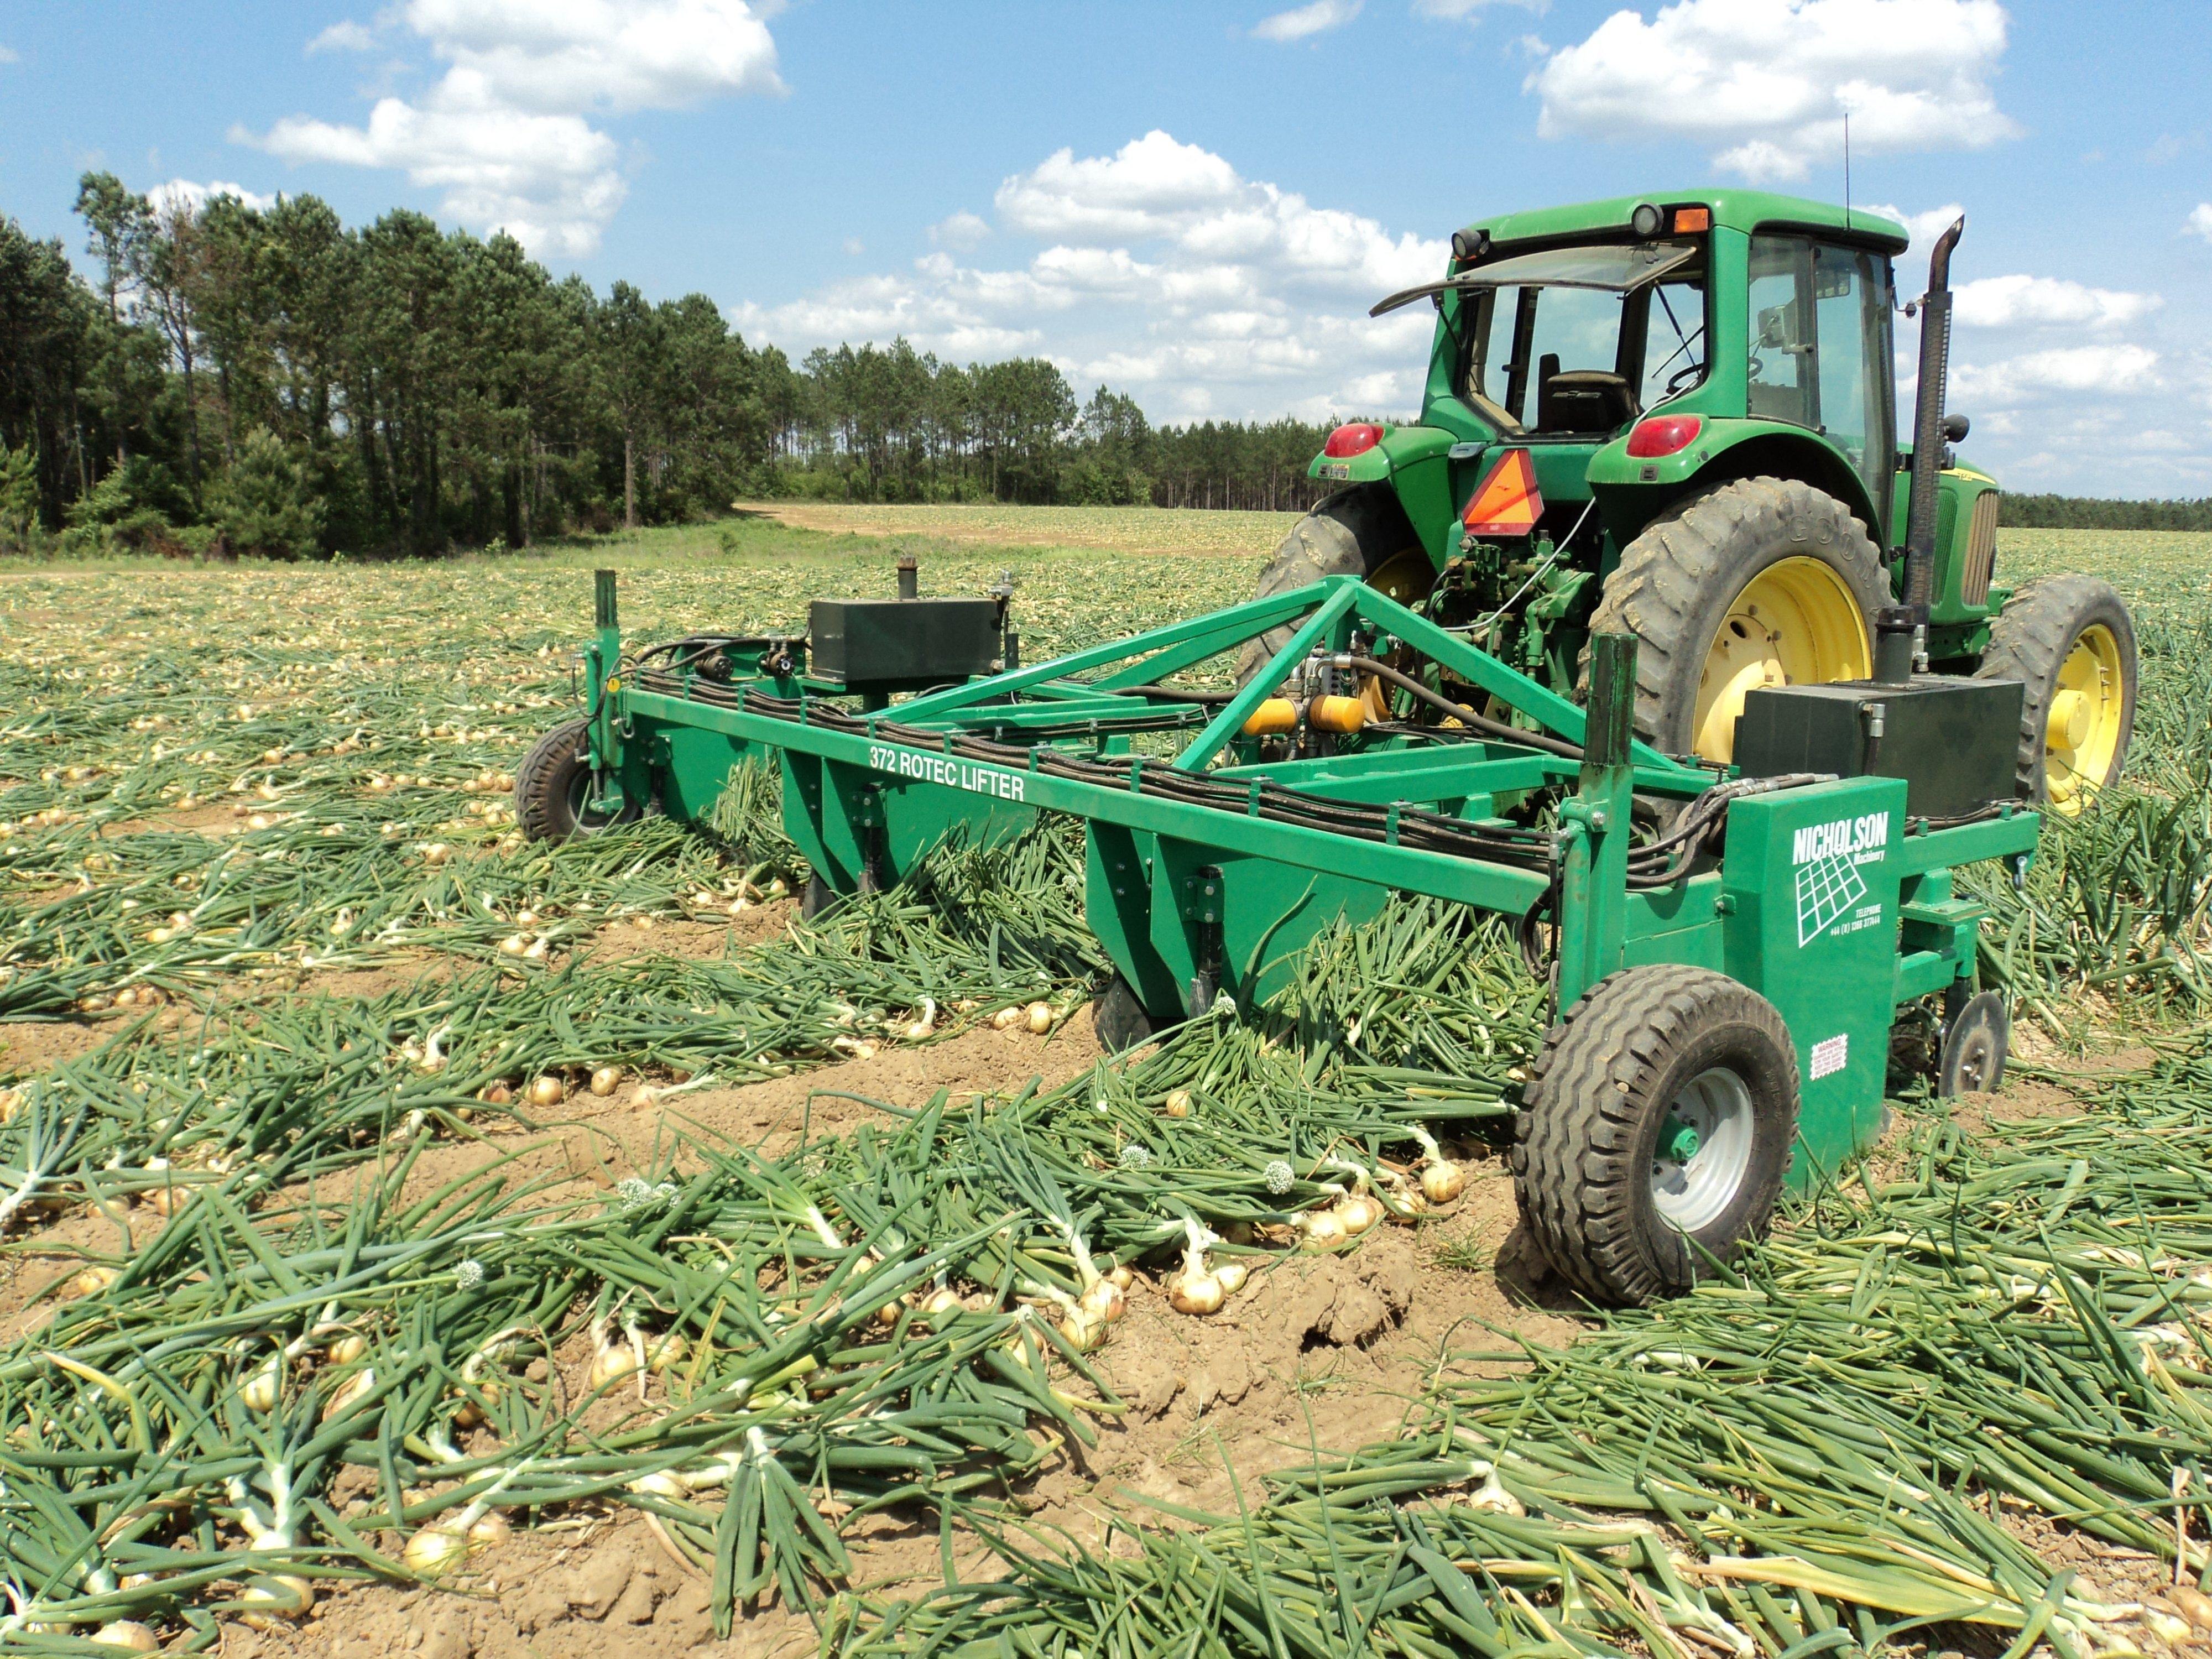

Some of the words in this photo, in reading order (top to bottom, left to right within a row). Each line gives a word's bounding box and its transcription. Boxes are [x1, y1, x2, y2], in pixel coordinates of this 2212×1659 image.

[869, 745, 895, 773] 372
[900, 752, 957, 786] ROTEC
[962, 765, 1025, 802] LIFTER
[1793, 811, 1888, 865] NICHOLSON
[1854, 850, 1885, 865] Machinery
[1856, 903, 1881, 919] TELEPHONE
[1830, 926, 1840, 936] +44
[1841, 922, 1850, 935] (0)
[1818, 1039, 1841, 1052] WARNING
